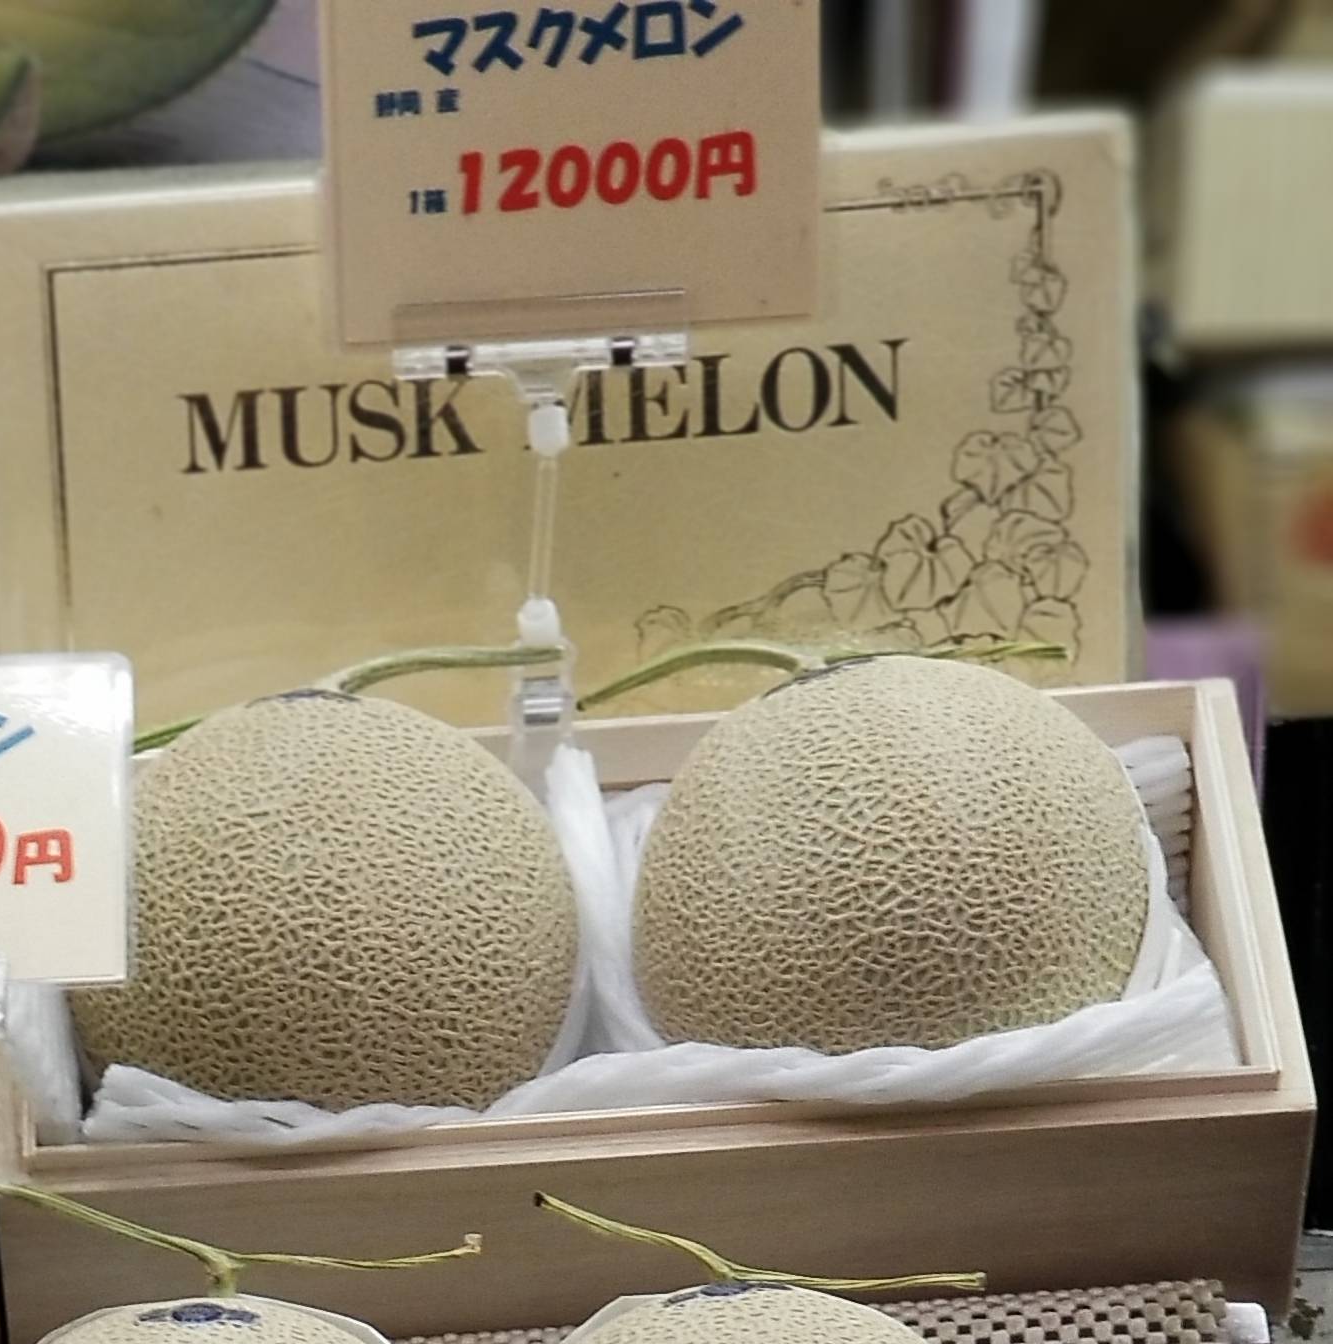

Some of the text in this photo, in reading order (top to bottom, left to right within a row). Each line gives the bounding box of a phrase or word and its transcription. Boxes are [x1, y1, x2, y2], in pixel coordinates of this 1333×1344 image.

[412, 0, 744, 76] マスクメロン
[458, 130, 758, 216] 12000円
[178, 375, 486, 474] MUSK
